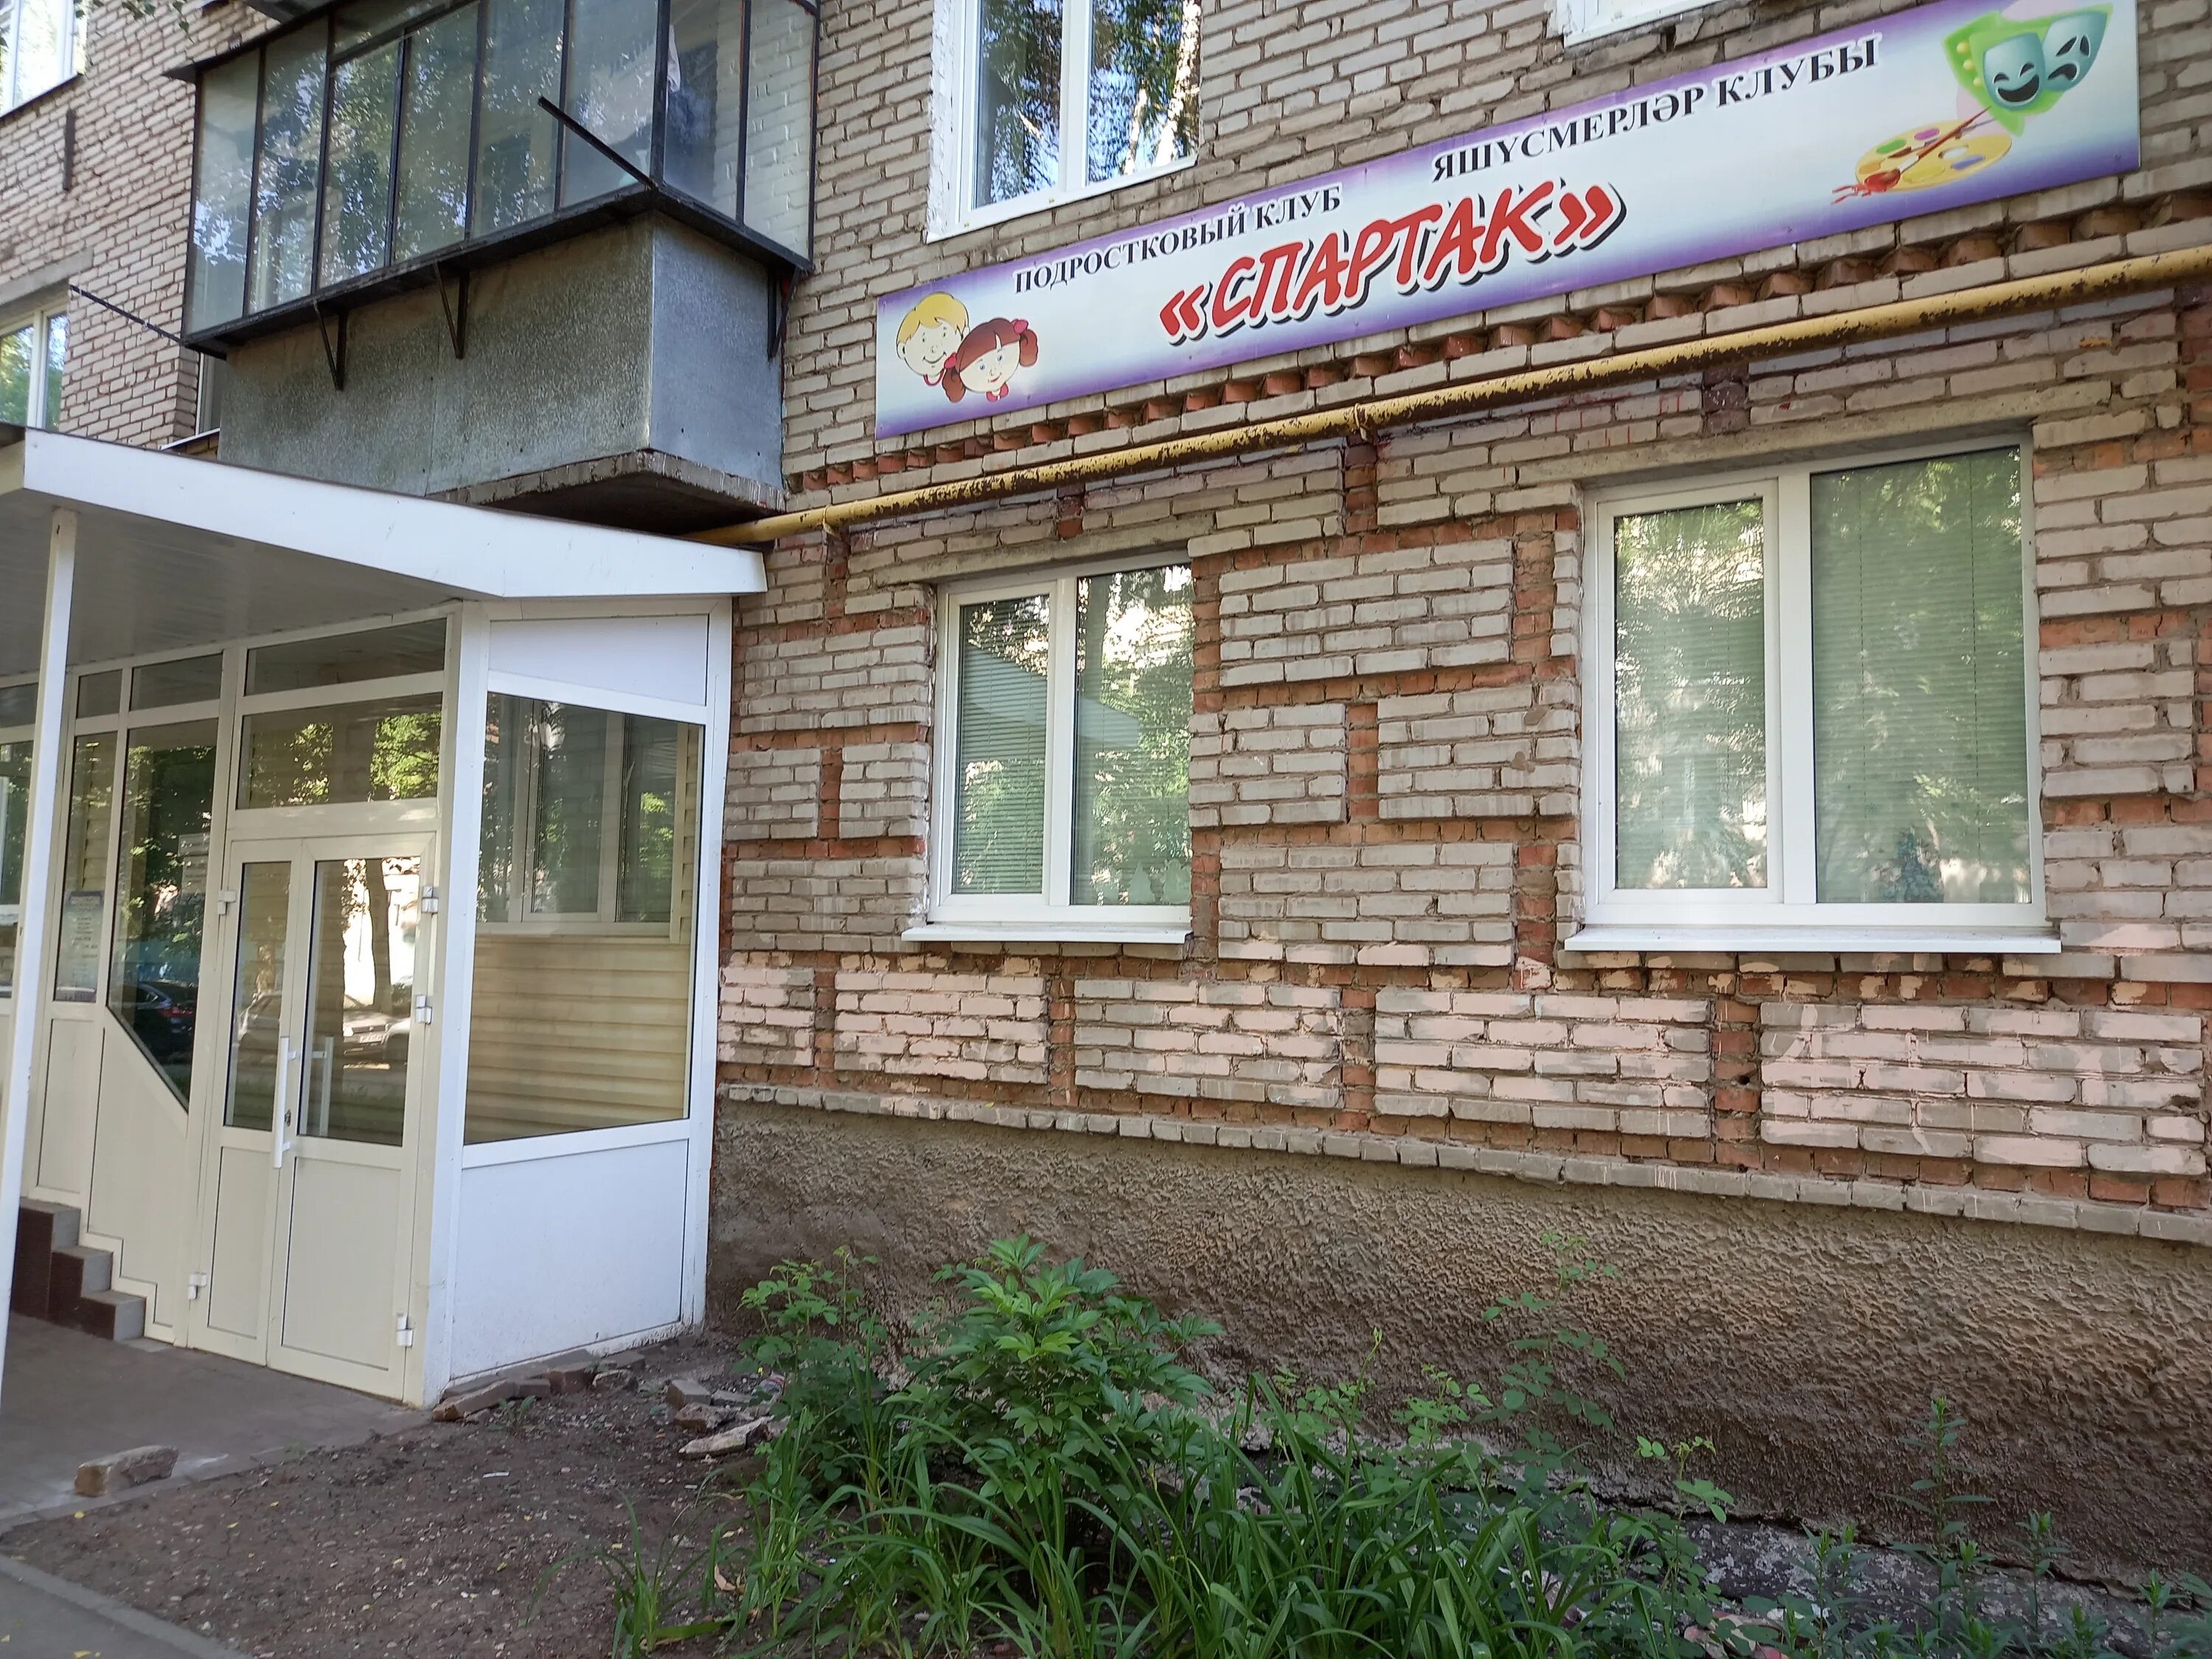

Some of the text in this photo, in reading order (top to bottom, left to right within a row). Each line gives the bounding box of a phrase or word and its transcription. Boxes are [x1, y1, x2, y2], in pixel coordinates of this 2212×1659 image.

[1433, 38, 1879, 181] ЯШҮСМЕРЛӘР КЛУБЫ
[1015, 186, 1341, 294] ПОДРОСТКОВЫЙ КЛУБ
[1160, 178, 1627, 346] «СПАРТАК»
